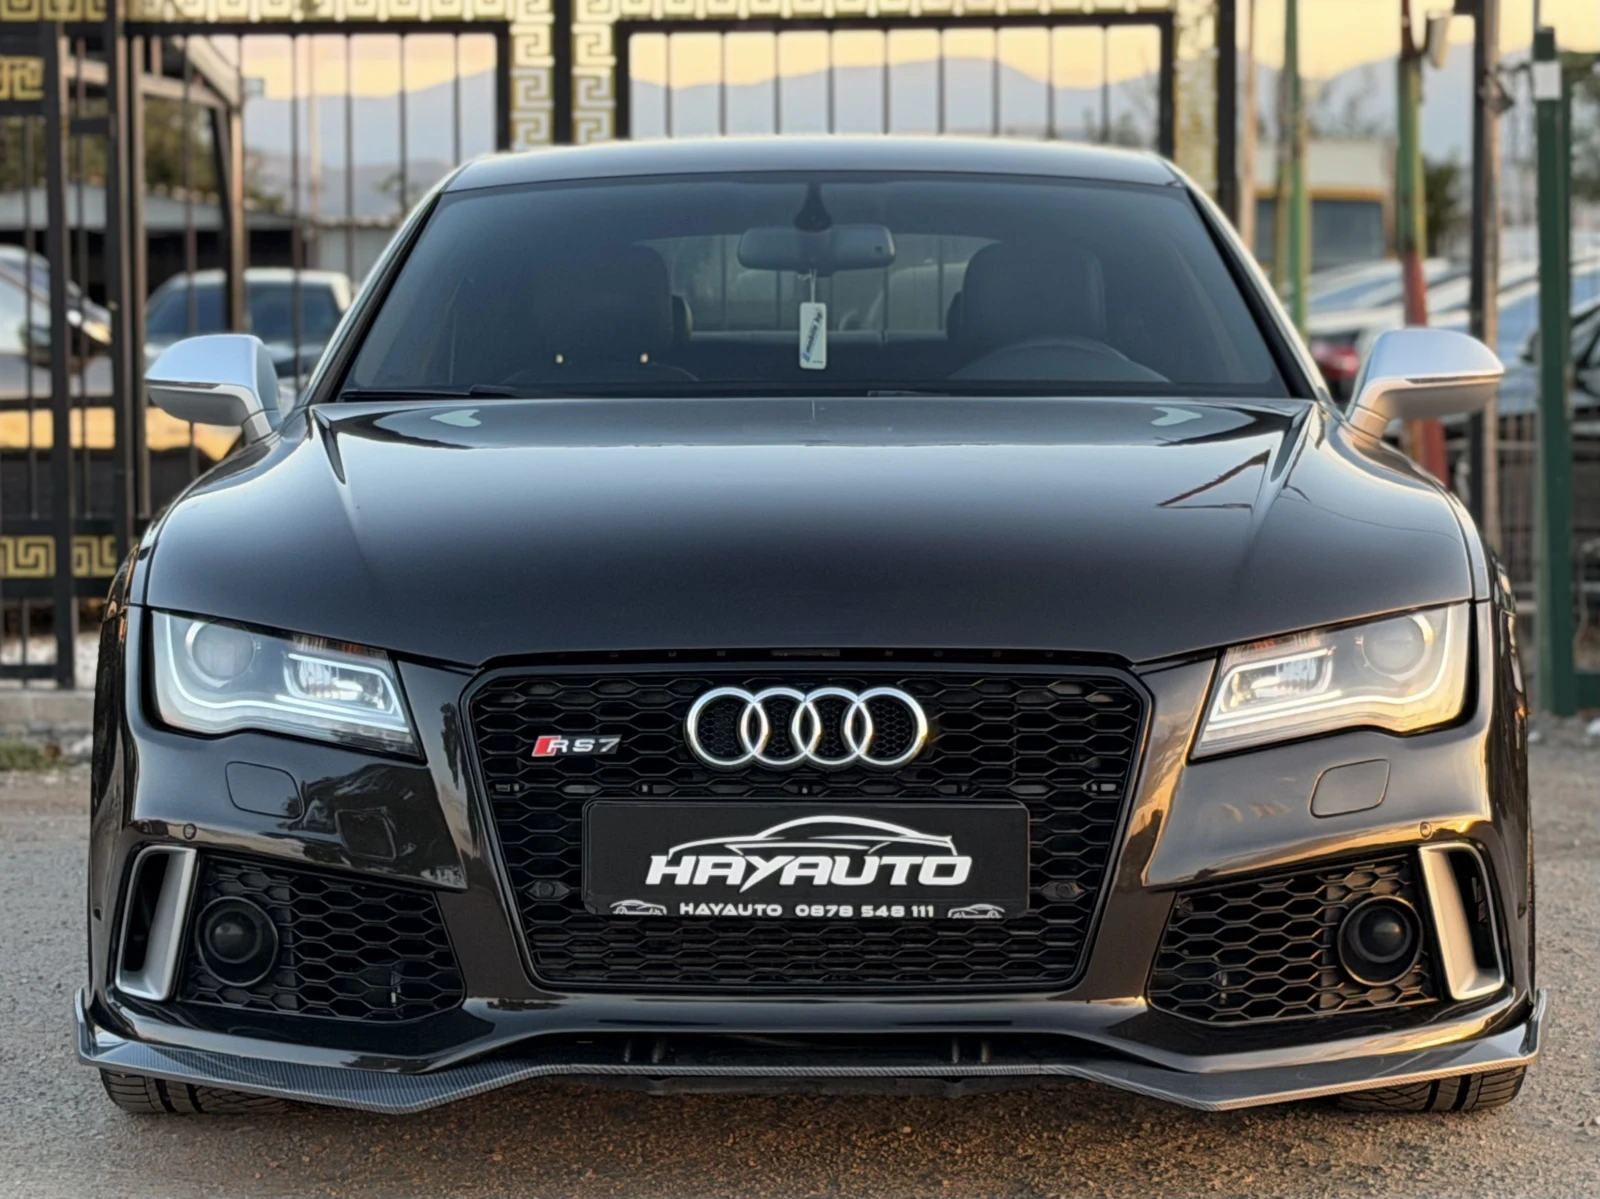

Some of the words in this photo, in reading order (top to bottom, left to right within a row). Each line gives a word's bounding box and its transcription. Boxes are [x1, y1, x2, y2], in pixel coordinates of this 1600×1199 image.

[546, 737, 621, 753] RS7
[645, 855, 972, 893] HAYAUTO
[679, 902, 783, 917] HAYAUTO
[794, 904, 854, 918] 0878
[860, 904, 906, 918] 548
[911, 905, 934, 918] 111
